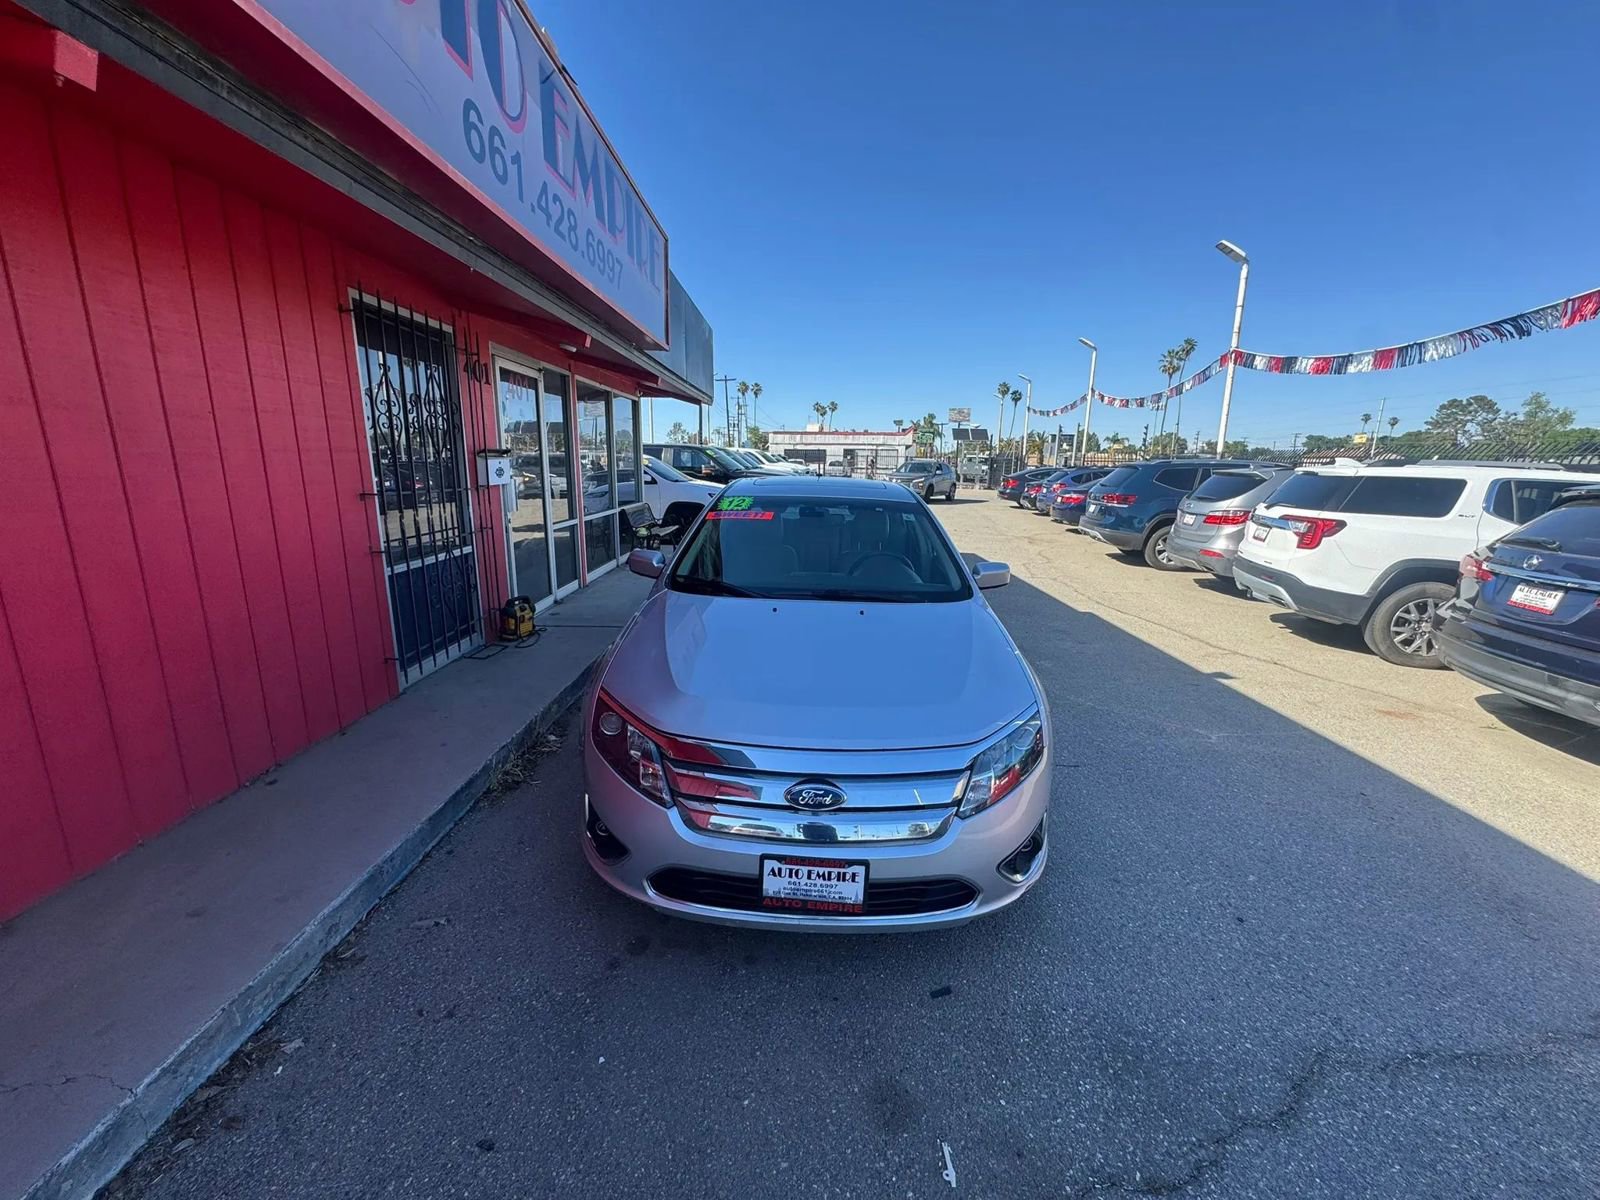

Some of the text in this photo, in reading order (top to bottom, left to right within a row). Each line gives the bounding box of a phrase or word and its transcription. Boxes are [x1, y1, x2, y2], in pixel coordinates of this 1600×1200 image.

[538, 62, 661, 293] EMPIRE
[462, 98, 623, 291] 661.428.6997
[798, 789, 832, 805] Ford
[767, 867, 860, 883] AUTO EMPIRE
[787, 880, 839, 889] 661.428.6997
[763, 898, 863, 913] AUTO EMPIRE
